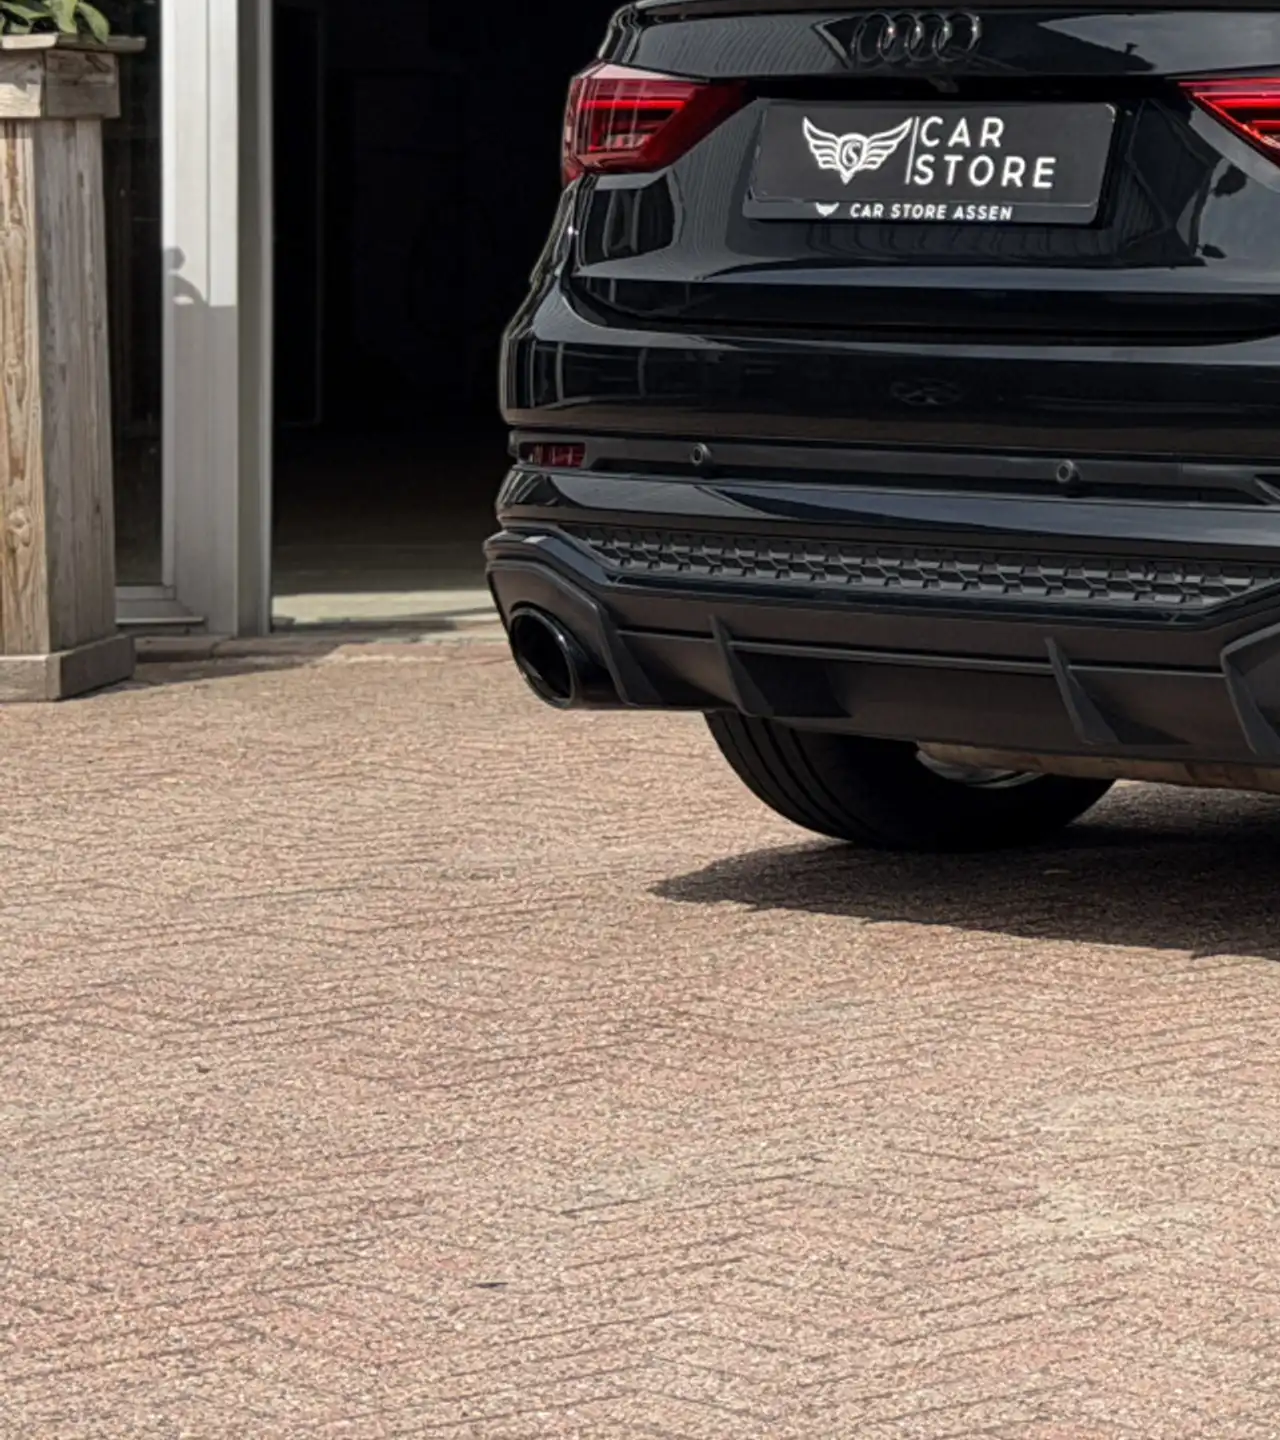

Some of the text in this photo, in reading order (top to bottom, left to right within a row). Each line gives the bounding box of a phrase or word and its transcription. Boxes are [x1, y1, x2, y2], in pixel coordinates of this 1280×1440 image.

[920, 117, 1004, 147] CAR
[914, 155, 1056, 188] STORE
[849, 203, 1013, 221] CAR STORE ASSEN
